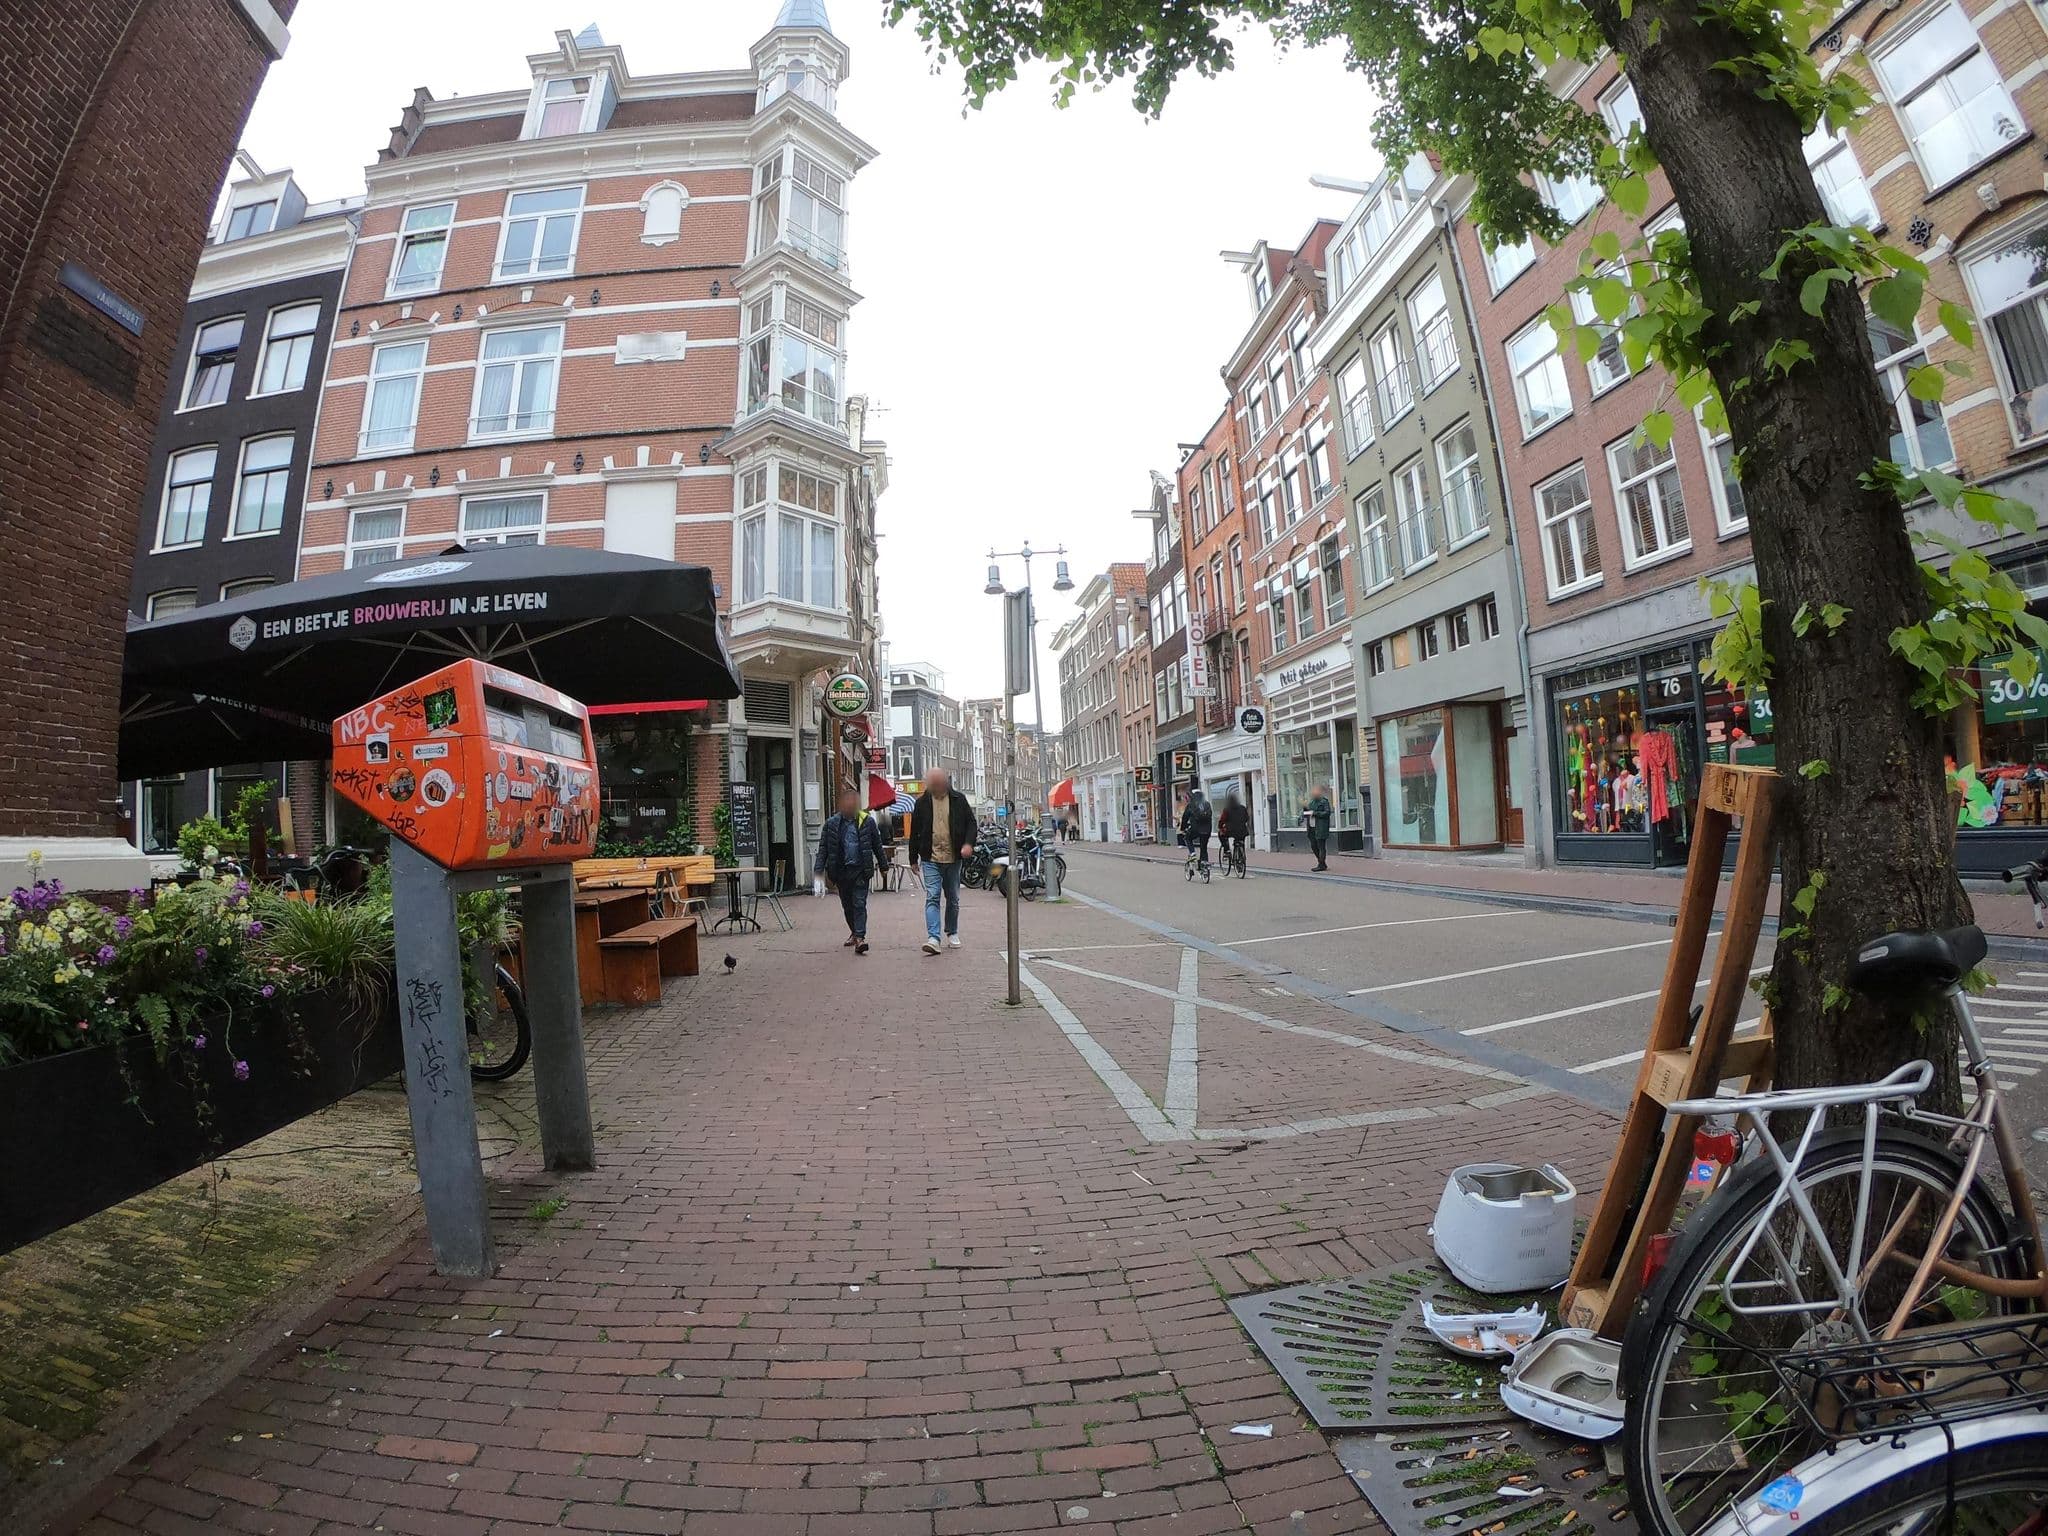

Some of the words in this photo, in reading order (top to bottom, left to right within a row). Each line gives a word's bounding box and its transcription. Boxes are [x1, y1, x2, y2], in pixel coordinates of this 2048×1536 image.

[263, 619, 290, 639] EEN
[295, 609, 349, 634] BEETJE
[354, 599, 445, 625] BROUWERIJ
[450, 597, 466, 615] IN
[471, 596, 489, 613] JE
[494, 592, 547, 612] LEVEN
[1190, 613, 1205, 687] HOTEL
[829, 690, 866, 699] Heineken
[1661, 677, 1681, 697] 76
[639, 806, 666, 817] Harlem
